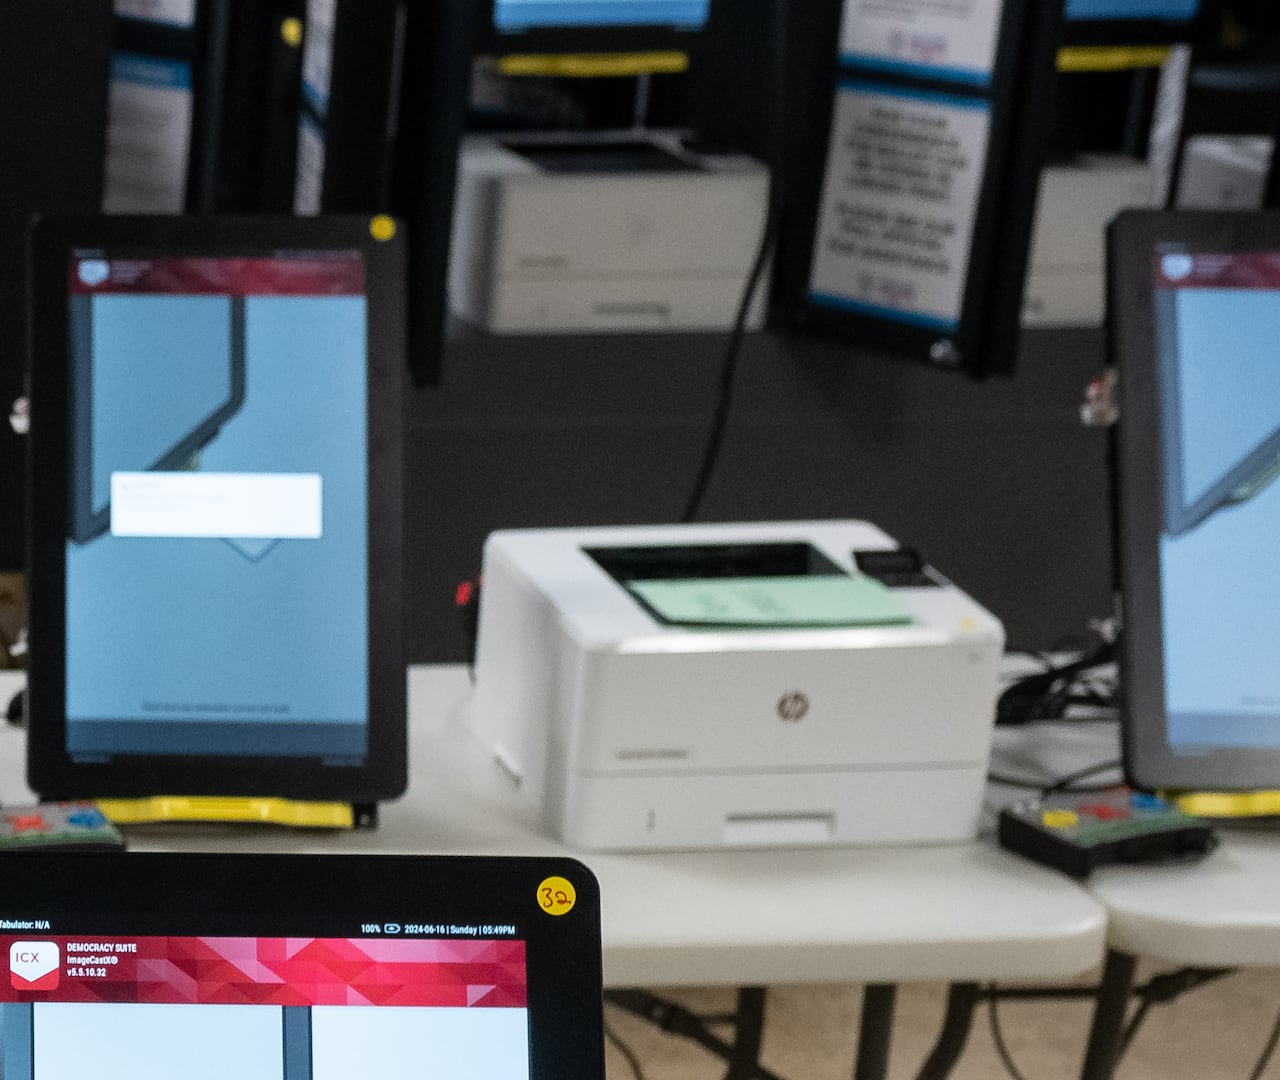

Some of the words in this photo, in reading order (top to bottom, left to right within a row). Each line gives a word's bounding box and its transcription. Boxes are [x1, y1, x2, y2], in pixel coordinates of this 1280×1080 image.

[541, 887, 572, 908] 32
[34, 920, 50, 929] N/A
[361, 924, 381, 933] 100%
[404, 924, 445, 934] 2024-06-16
[450, 925, 478, 936] Sunday
[482, 925, 516, 935] 05:49PM
[67, 943, 114, 953] DEMOCRACY
[115, 943, 137, 953] SUITE
[15, 952, 39, 963] ICX
[67, 968, 106, 977] v5.5.10.32
